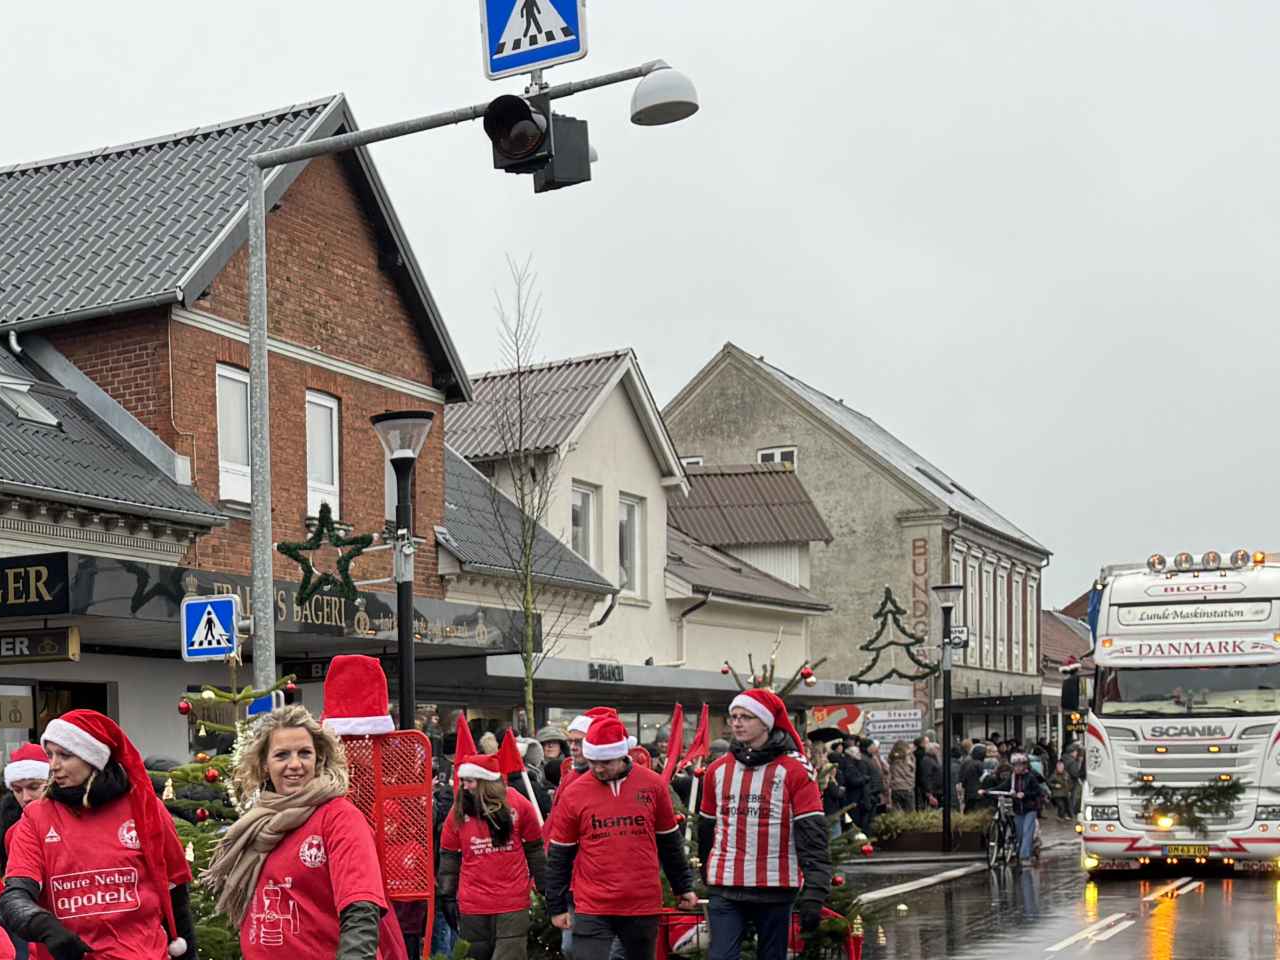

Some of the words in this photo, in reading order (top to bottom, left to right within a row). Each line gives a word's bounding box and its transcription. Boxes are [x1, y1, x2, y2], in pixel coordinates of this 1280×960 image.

[1163, 584, 1228, 593] BLOCH
[1139, 608, 1169, 621] Lunde
[1171, 606, 1244, 620] Maskinstation
[1138, 640, 1246, 656] DANMARK
[1151, 725, 1226, 737] SCANIA
[591, 814, 646, 830] home
[53, 878, 90, 892] Nørre
[94, 871, 135, 886] Nebel
[57, 887, 135, 912] apotek
